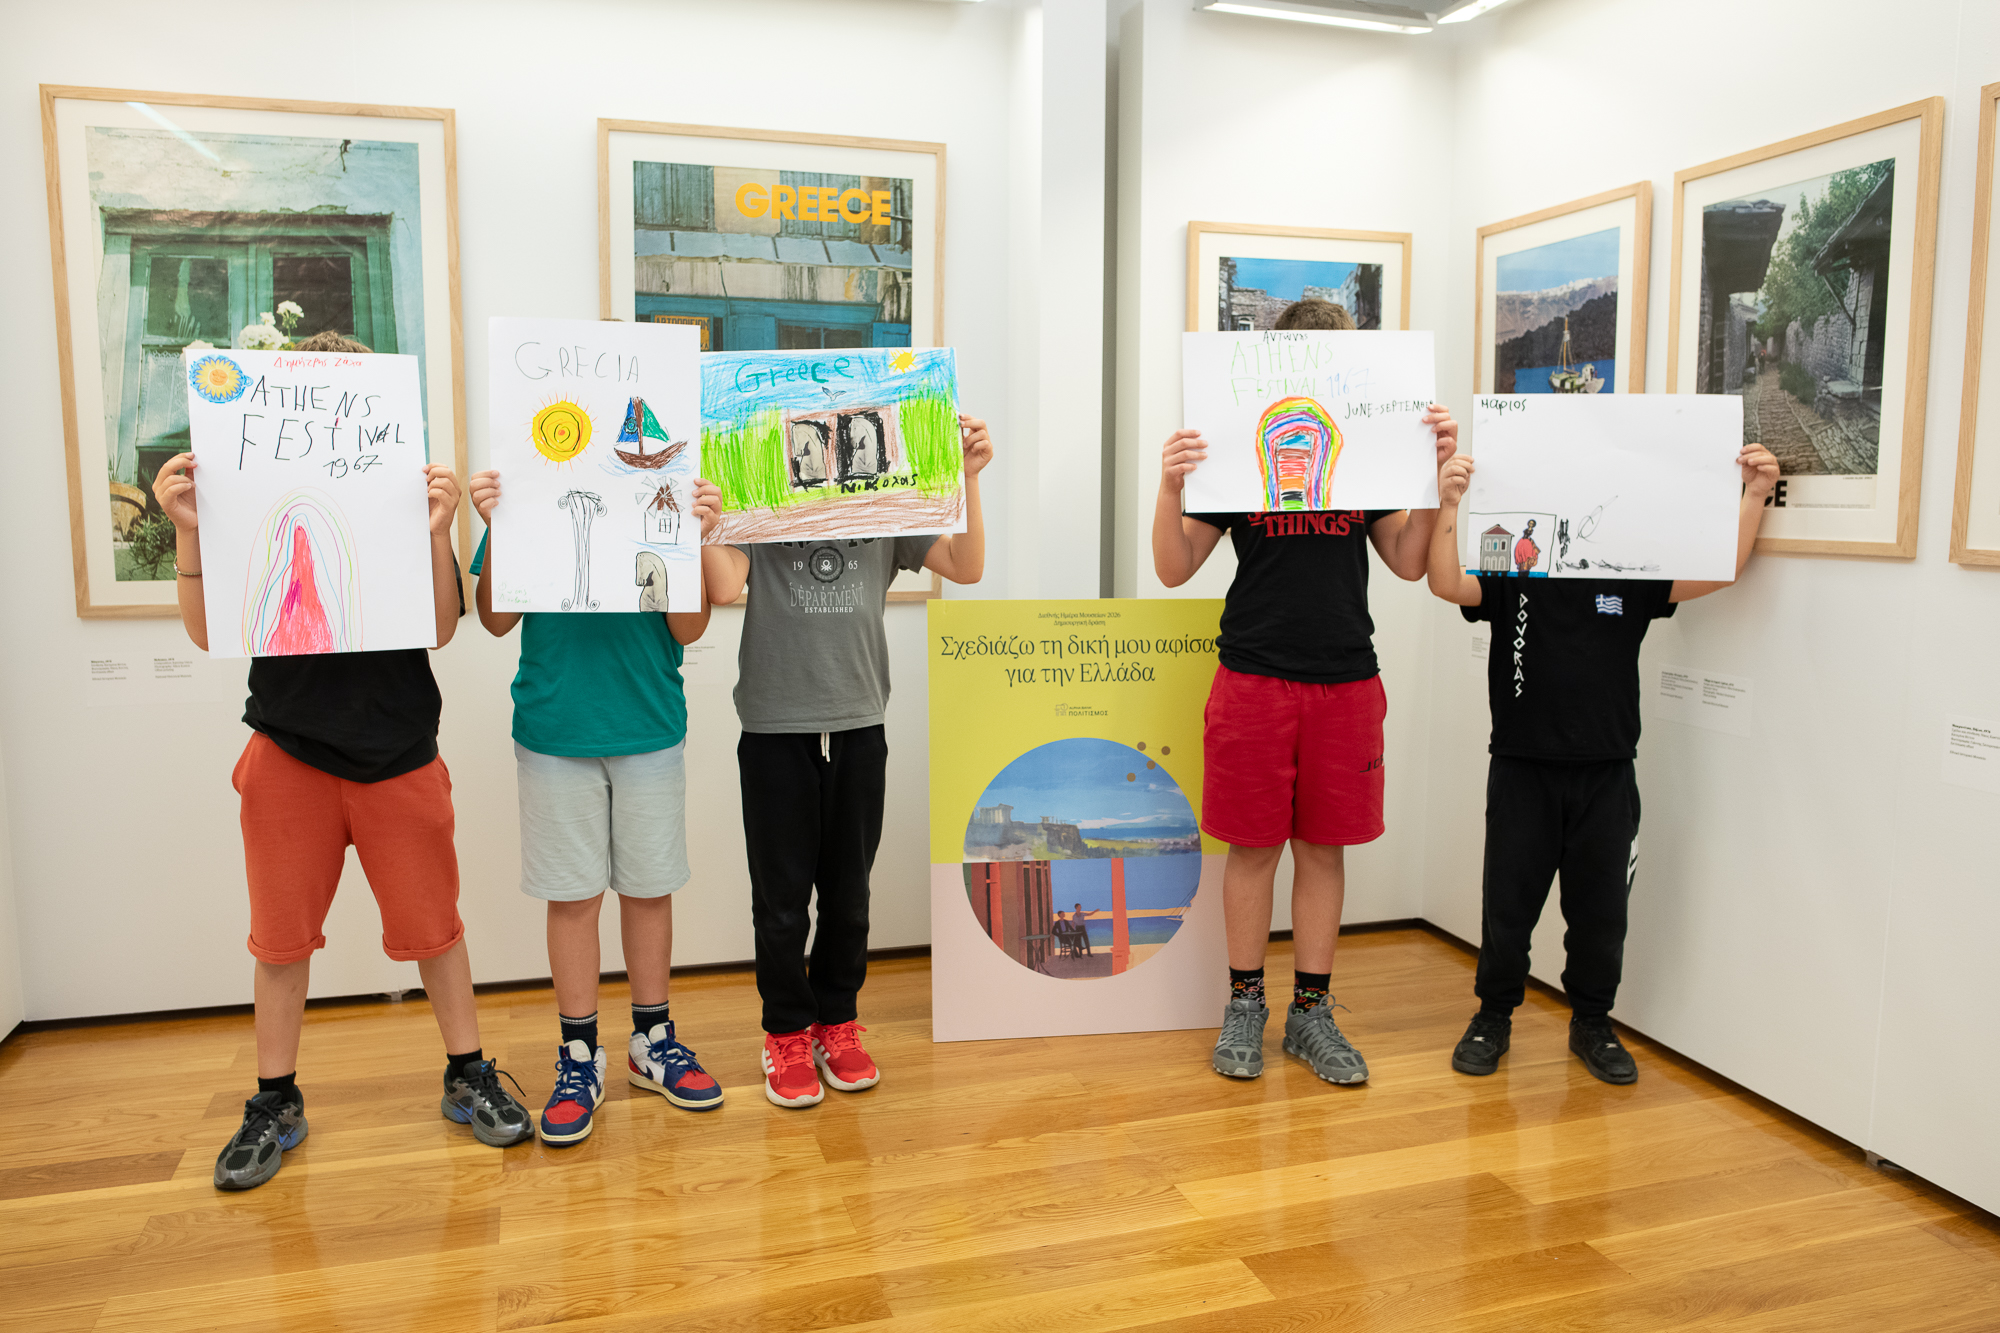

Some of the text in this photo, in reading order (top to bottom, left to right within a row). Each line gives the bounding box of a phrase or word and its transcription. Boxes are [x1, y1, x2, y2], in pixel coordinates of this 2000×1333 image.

[735, 182, 891, 226] GREECE
[515, 341, 639, 383] GRECIA
[1230, 341, 1333, 375] ATHENS
[735, 357, 854, 393] Greece
[1231, 367, 1376, 407] FESTIVAL 1967
[251, 375, 381, 418] ATHENS
[239, 413, 405, 470] FESTIVAL
[323, 454, 383, 479] 1967
[1264, 513, 1351, 537] THINGS
[793, 560, 858, 571] 19 65
[789, 581, 863, 591] CLOTHING
[789, 585, 865, 607] DEPARTMENT
[804, 605, 854, 613] ESTABLISHED
[941, 634, 1217, 660] Σχεδιάζω τη δική μου αφίσα
[1005, 662, 1156, 687] για την Ελλάδα
